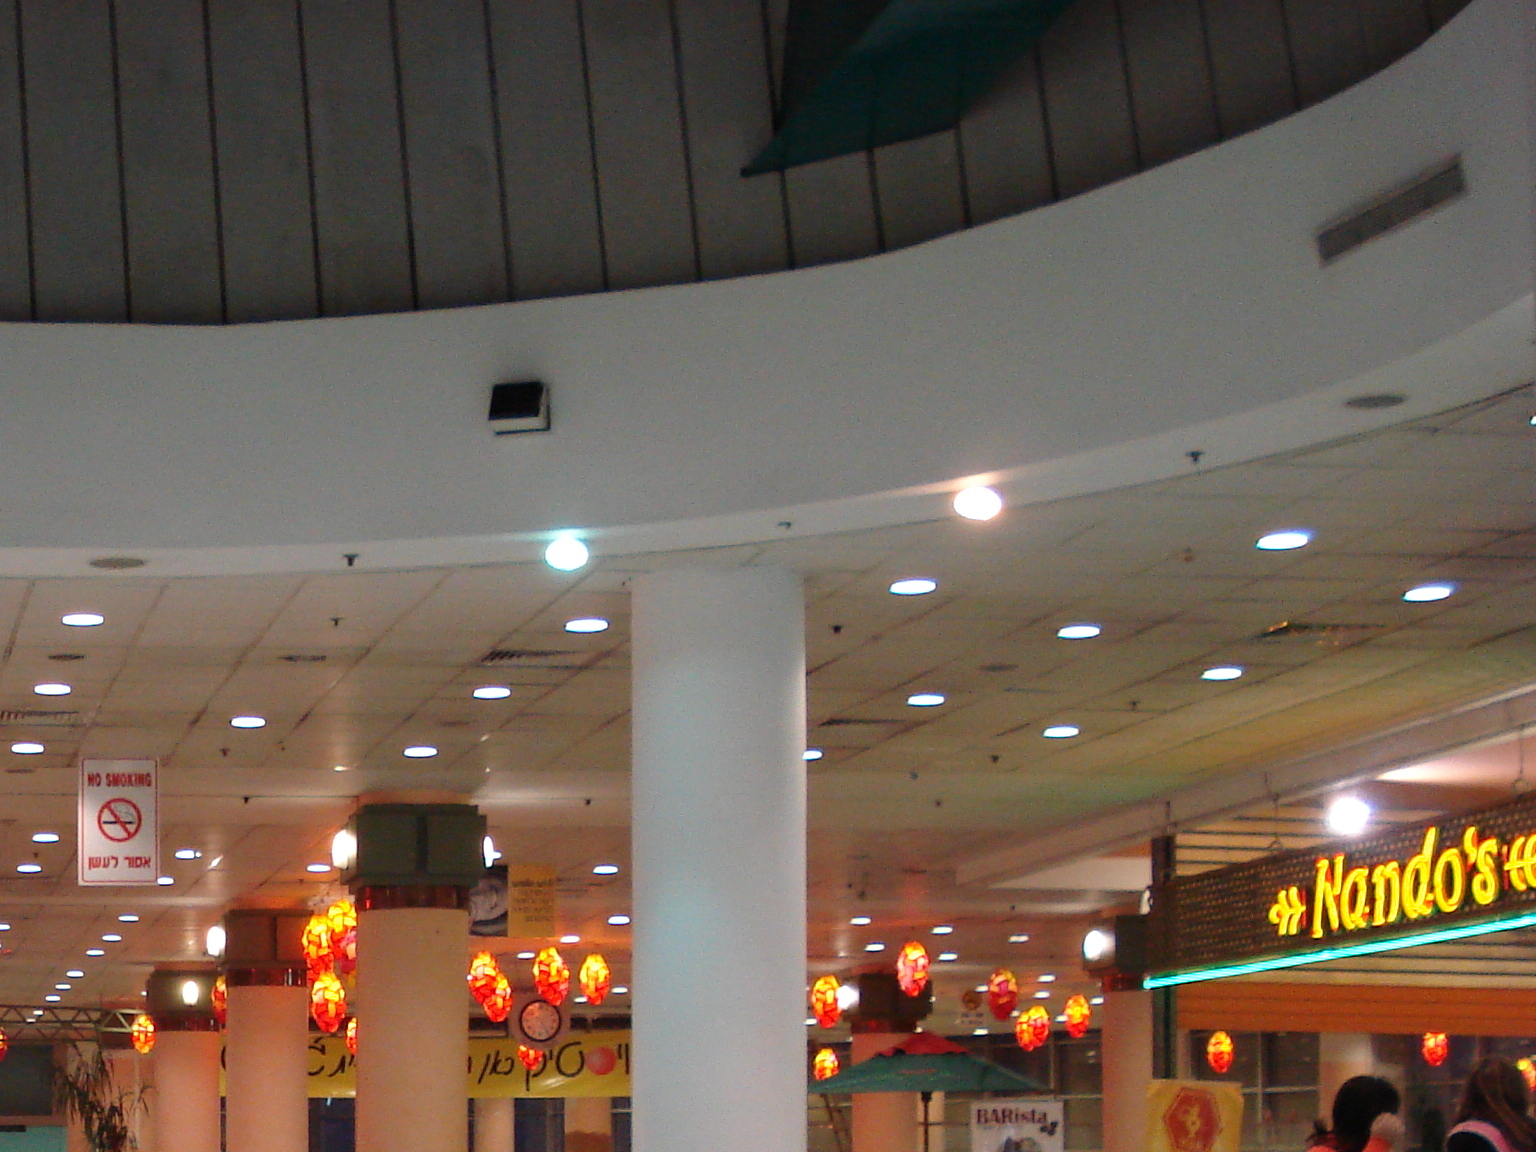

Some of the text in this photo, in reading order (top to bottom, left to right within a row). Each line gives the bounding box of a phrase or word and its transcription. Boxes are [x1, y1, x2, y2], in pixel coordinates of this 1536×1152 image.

[87, 772, 152, 787] NO SMOKING
[88, 855, 151, 870] אסור לעשן
[1311, 826, 1498, 938] Nando's
